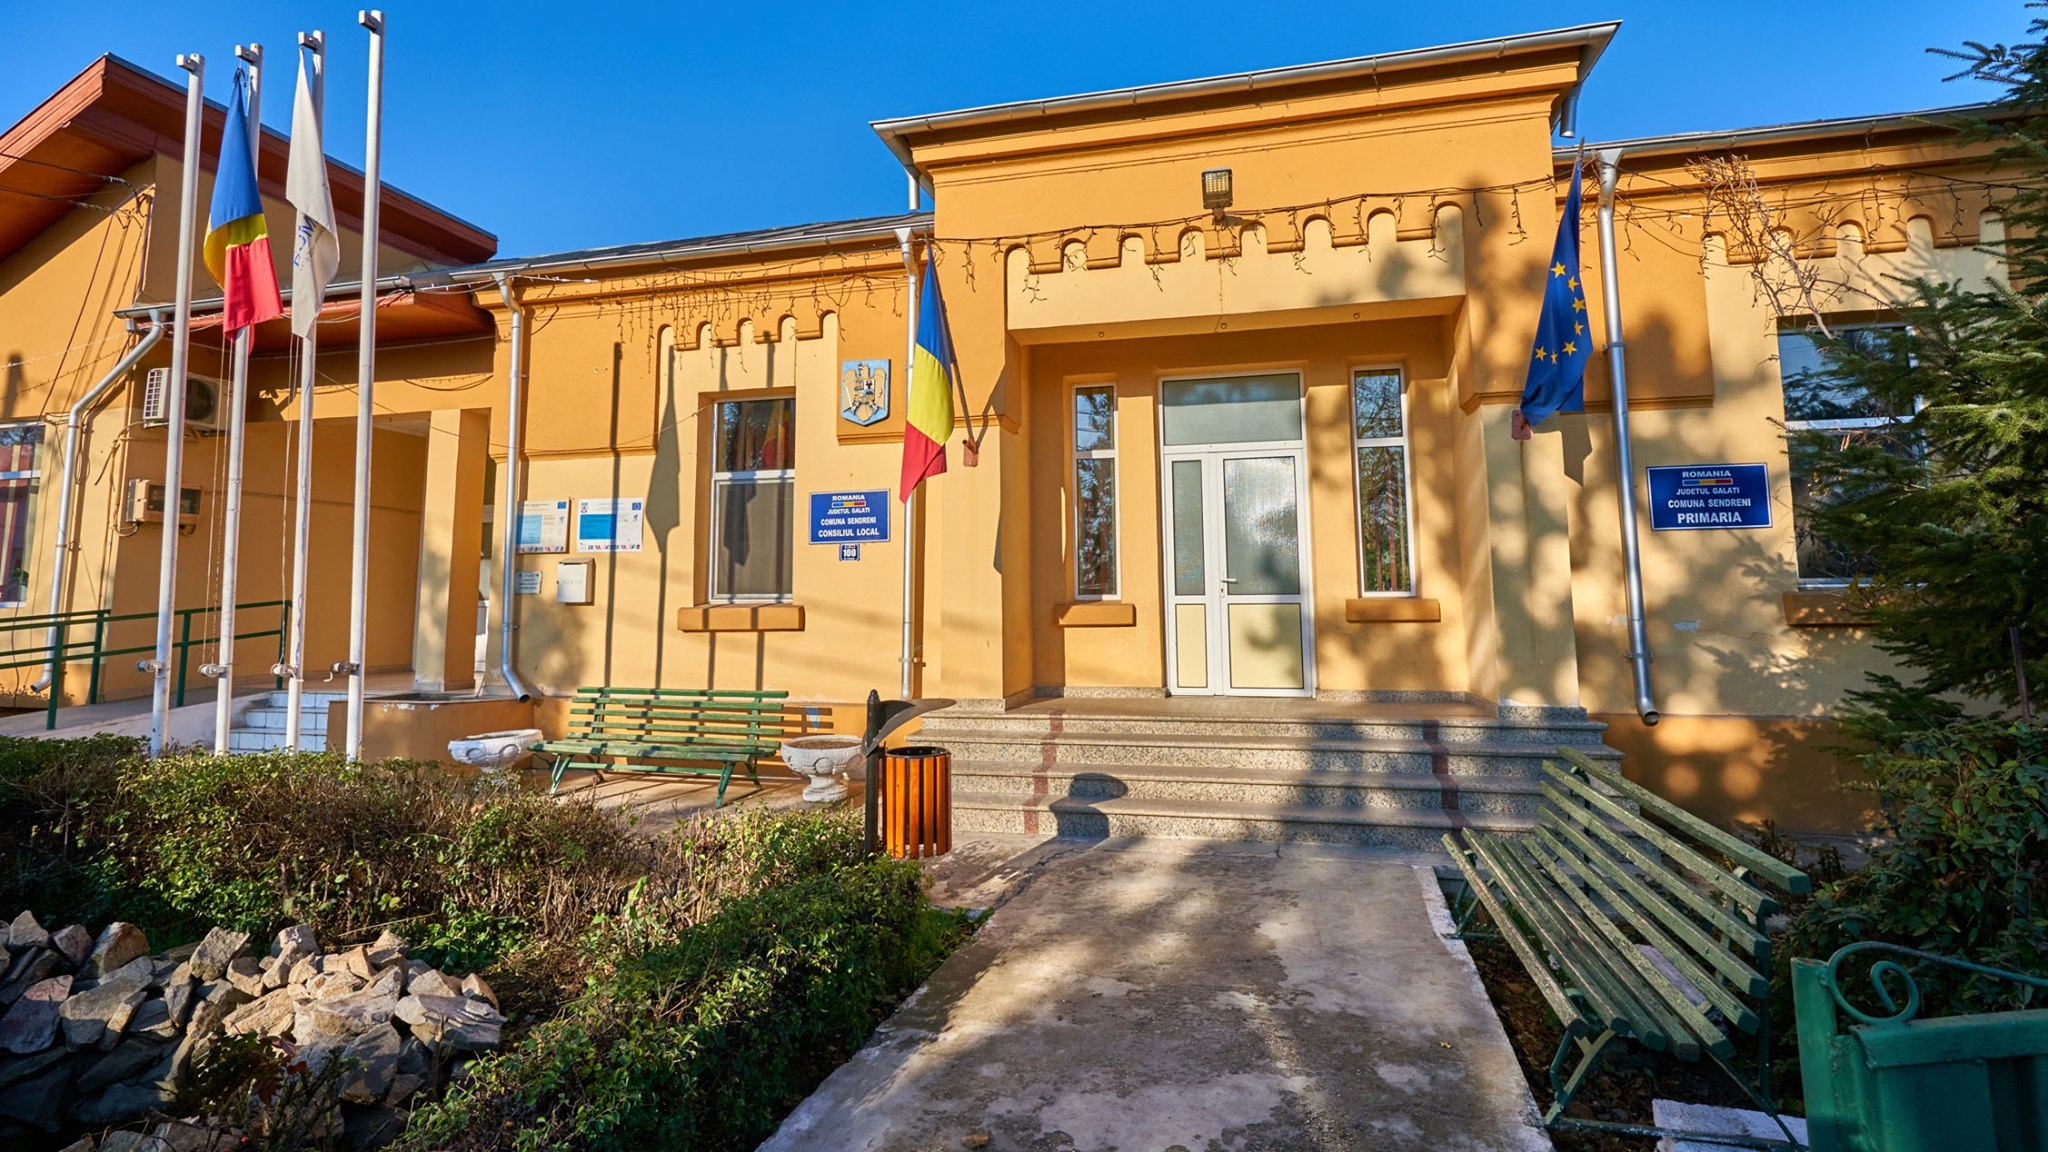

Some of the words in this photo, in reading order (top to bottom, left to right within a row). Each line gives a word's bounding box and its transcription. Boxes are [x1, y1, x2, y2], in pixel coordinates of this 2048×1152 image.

[1668, 499, 1705, 509] COMUNA
[1708, 498, 1751, 507] SENDRENI
[820, 518, 846, 526] COMUNA
[847, 517, 877, 525] SENDRENI
[1677, 511, 1742, 524] PRIMARIA
[818, 529, 854, 537] CONSILIUL
[856, 528, 880, 536] LOCAL
